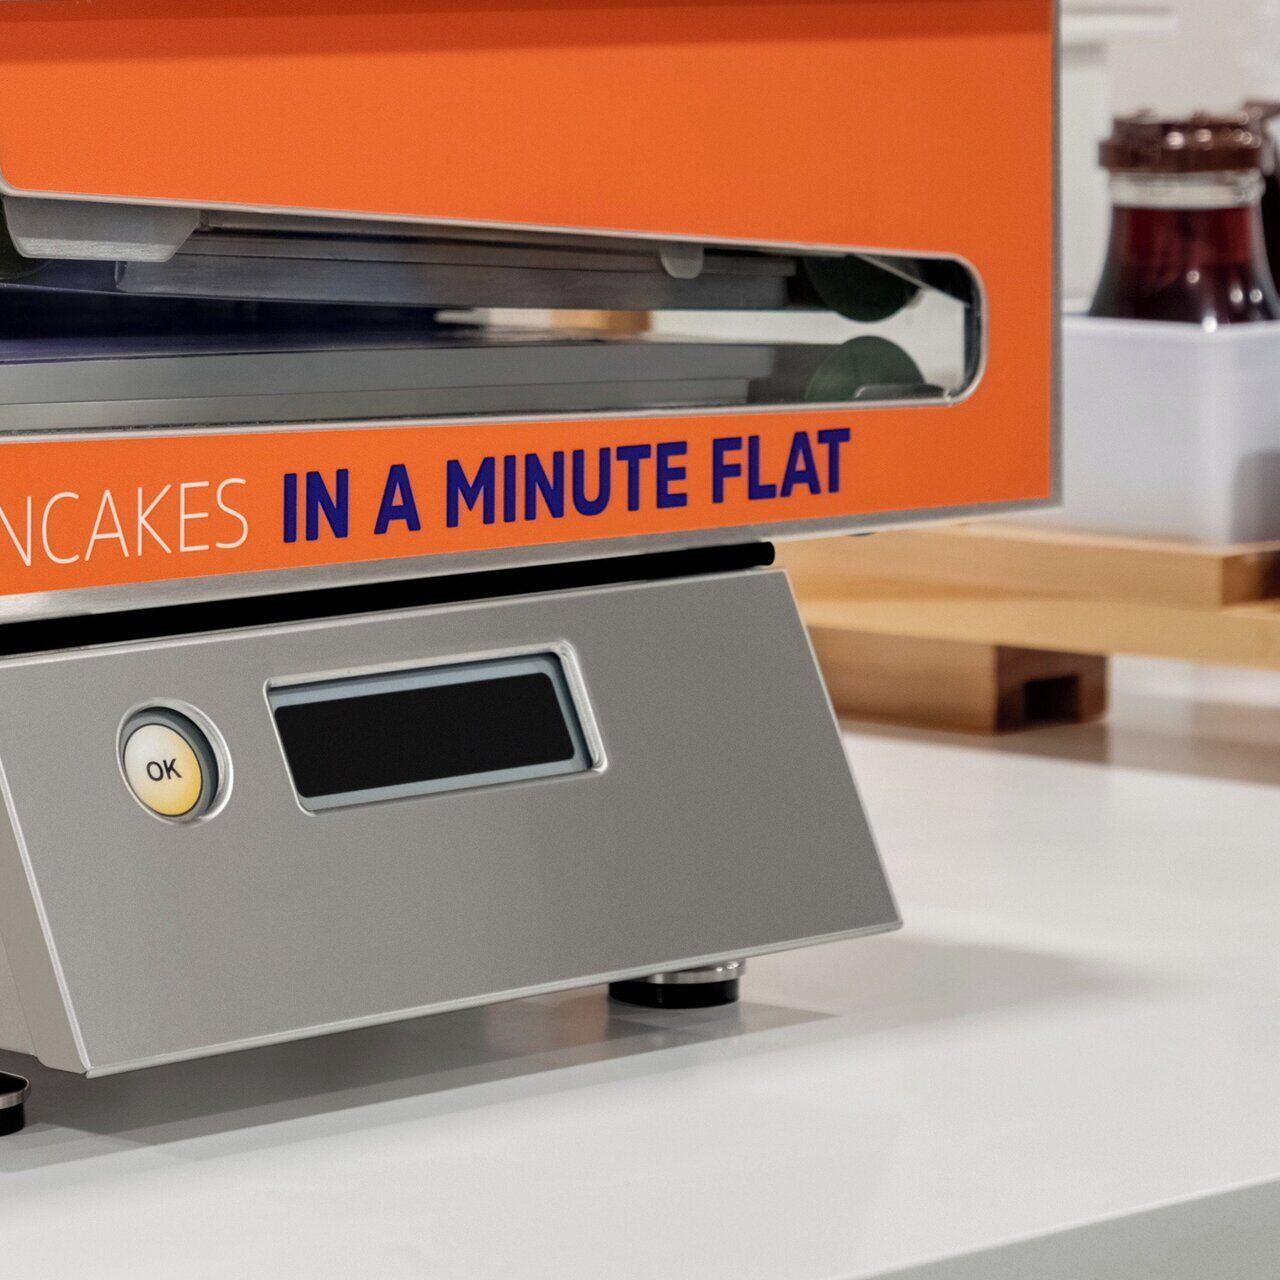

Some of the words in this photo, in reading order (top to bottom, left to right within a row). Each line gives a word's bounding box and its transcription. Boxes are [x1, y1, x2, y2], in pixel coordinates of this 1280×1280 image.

[283, 468, 349, 543] IN
[373, 463, 421, 535] A
[446, 441, 688, 528] MINUTE
[711, 427, 851, 504] FLAT
[146, 758, 182, 782] OK
